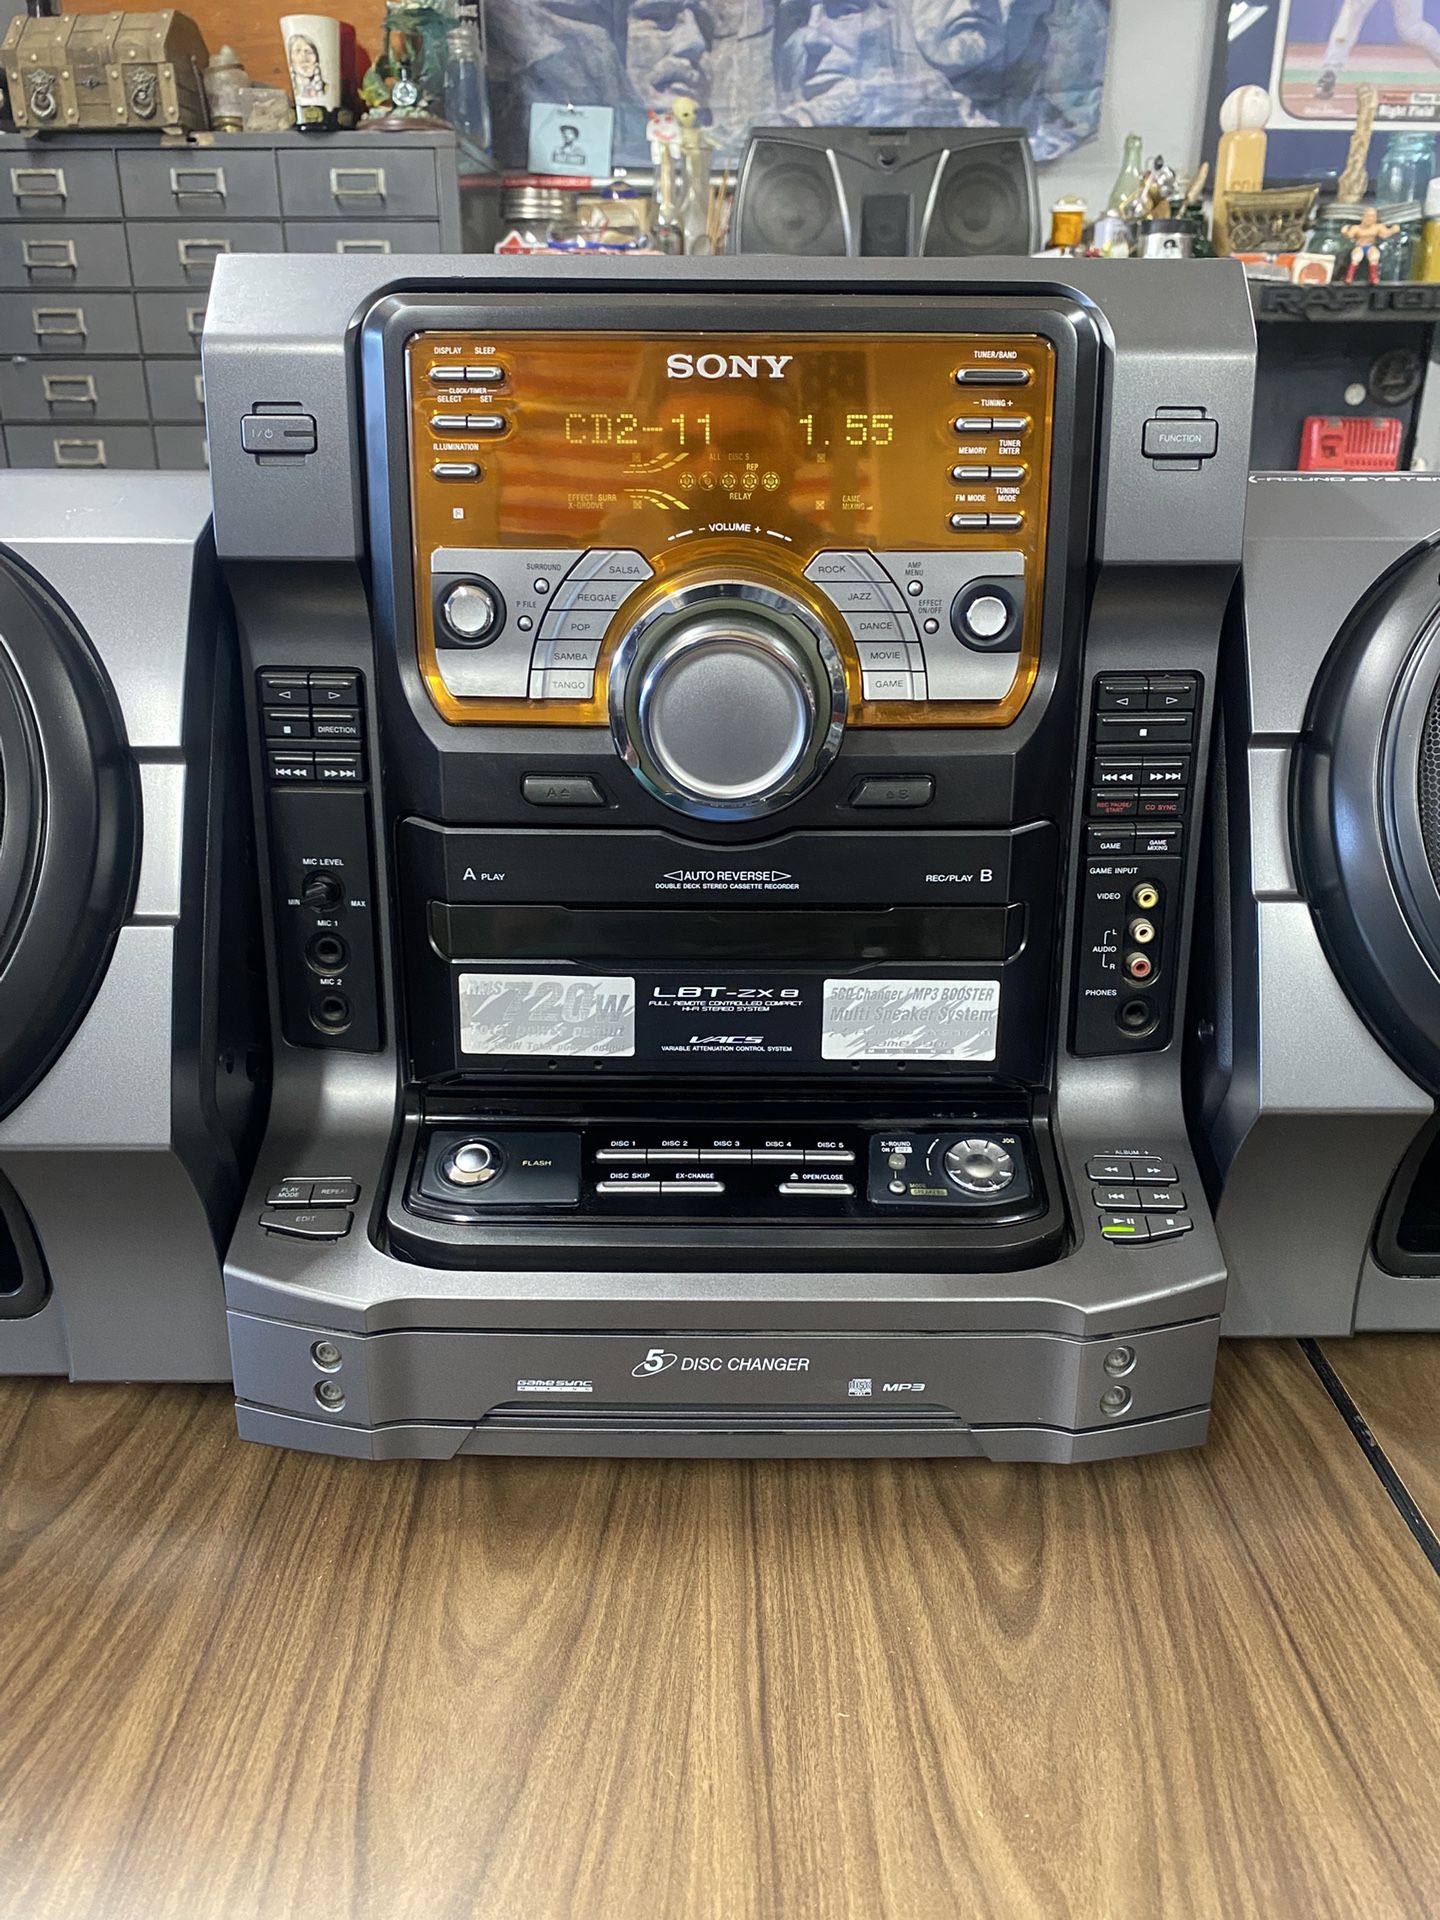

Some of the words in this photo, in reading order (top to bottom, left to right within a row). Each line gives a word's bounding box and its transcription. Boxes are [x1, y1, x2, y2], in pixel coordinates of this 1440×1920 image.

[1262, 285, 1440, 315] RAPTO
[434, 346, 462, 355] DISPLAY
[474, 346, 496, 355] SLEEP
[974, 350, 1018, 359] TUNER/BAND
[666, 353, 794, 379] SONY
[448, 387, 488, 395] CLOCK/TIMER
[437, 395, 462, 403] SELECT
[480, 395, 493, 403] SET
[981, 399, 1006, 407] TUNING
[566, 413, 711, 445] CD2-11
[800, 413, 894, 446] 1.55
[1159, 433, 1202, 443] FUNCTION
[433, 442, 480, 451] ILLUMINATION
[999, 439, 1021, 447] TUNER
[958, 446, 987, 455] MEMORY
[998, 447, 1021, 455] ENTER
[746, 463, 759, 471] REP
[995, 487, 1020, 495] TUNING
[567, 493, 593, 502] EFFECT
[729, 492, 752, 500] RELAY
[955, 494, 966, 502] FM
[967, 494, 986, 502] MODE
[997, 494, 1017, 502] MODE
[709, 522, 752, 533] VOLUME
[526, 563, 562, 571] SURROUND
[818, 565, 846, 574] ROCK
[907, 561, 921, 569] AMP
[609, 565, 640, 575] SALSA
[905, 569, 924, 577] MENU
[577, 593, 617, 602] REGGAE
[847, 592, 872, 601] JAZZ
[918, 599, 943, 607] EFFECT
[918, 606, 942, 615] ON/OFF
[570, 623, 590, 632] POP
[859, 621, 893, 631] DANCE
[553, 652, 588, 661] SAMBA
[870, 651, 901, 660] MOVIE
[552, 680, 585, 690] TANGO
[875, 679, 904, 689] GAME
[318, 725, 357, 734] DIRECTION
[1096, 801, 1110, 809] REC
[1157, 803, 1177, 811] SYNC
[1100, 842, 1121, 850] GAME
[302, 858, 318, 866] MIC
[319, 858, 345, 866] LEVEL
[462, 867, 477, 881] A
[481, 873, 505, 881] PLAY
[925, 874, 974, 882] REC/PLAY
[979, 868, 993, 883] B
[1089, 867, 1112, 875] GAME
[1114, 867, 1138, 875] INPUT
[683, 870, 715, 882] AUTO
[716, 870, 771, 882] REVERSE
[1096, 892, 1121, 900] VIDEO
[288, 898, 301, 906] MIN
[350, 900, 366, 908] MAX
[317, 919, 332, 927] MIC
[319, 978, 335, 986] MIC
[336, 978, 342, 986] 2
[780, 988, 800, 998] 8
[912, 987, 938, 1001] MP3
[940, 987, 994, 1001] BOOSTER
[1085, 989, 1117, 997] PHONES
[830, 1006, 871, 1022] Multi
[873, 1006, 936, 1025] Speaker
[937, 1006, 994, 1025] System
[675, 1172, 715, 1180] EX-CHANGE
[802, 1173, 844, 1181] OPEN/CLOSE
[680, 1357, 723, 1371] DISC
[727, 1357, 810, 1372] CHANGER
[882, 1382, 927, 1392] MP3
